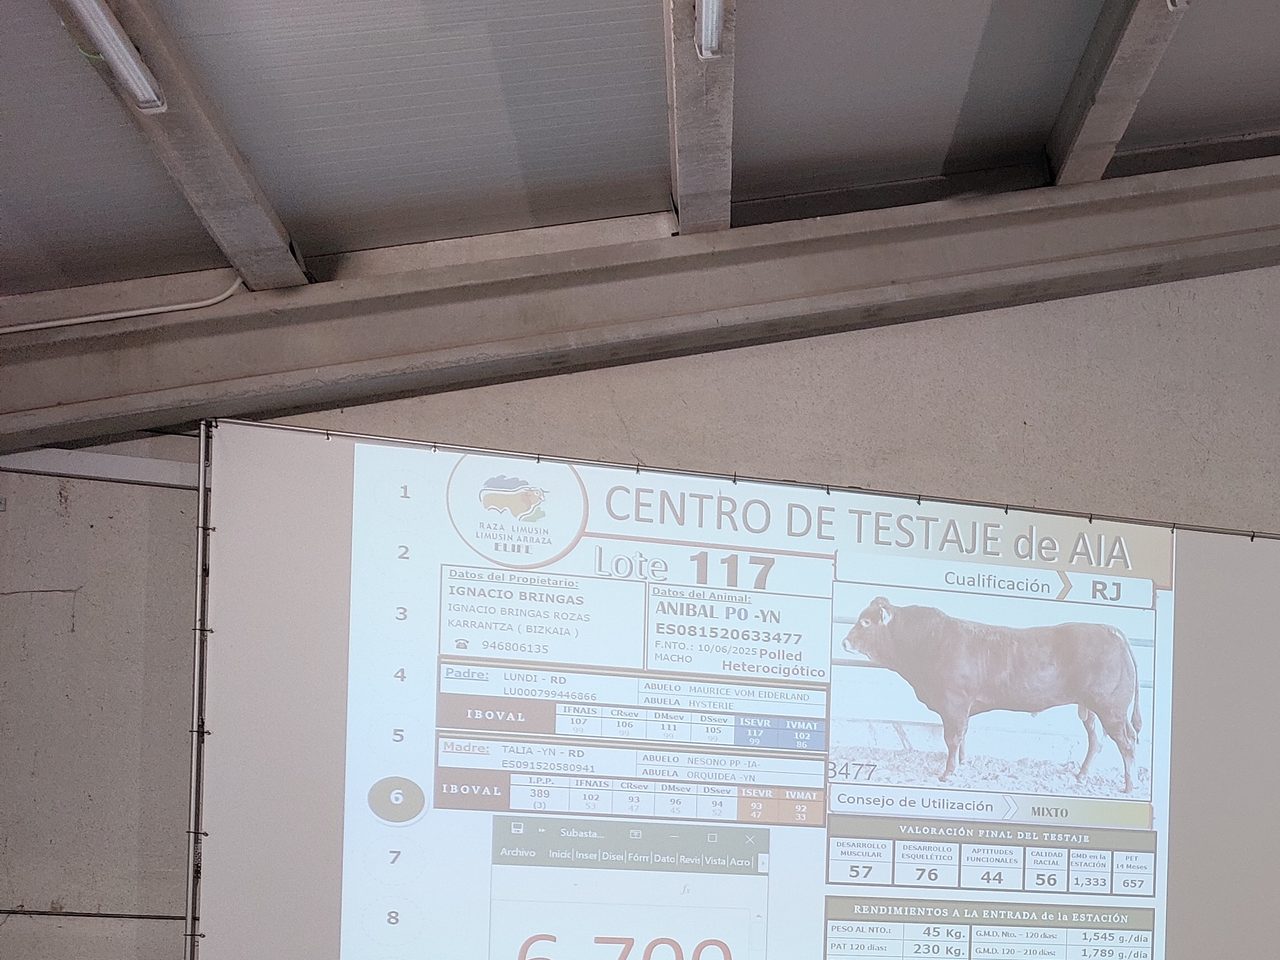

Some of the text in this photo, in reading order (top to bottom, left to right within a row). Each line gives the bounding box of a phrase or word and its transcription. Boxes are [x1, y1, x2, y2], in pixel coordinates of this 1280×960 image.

[400, 485, 411, 499] 1
[512, 525, 549, 535] LIMUSIN
[605, 486, 1133, 570] CENTRO DE TESTAJE de AIA
[476, 532, 513, 541] LIMUSIN
[398, 545, 410, 559] 2
[594, 545, 776, 590] Lote 117
[449, 570, 579, 588] Datos del Propietario:
[944, 571, 1122, 601] Cualificación RJ
[449, 586, 585, 606] IGNACIO BRINGAS
[652, 587, 752, 603] Datos del Animal:
[395, 607, 408, 620] 3
[448, 604, 591, 622] IGNACIO BRINGAS ROZAS
[655, 600, 719, 619] ANIBAL
[754, 609, 781, 624] -YN
[447, 619, 571, 636] KARRANTZA BIZKAIA
[656, 623, 802, 645] ES081520633477
[482, 640, 549, 654] 946806135
[698, 644, 758, 656] 10/06/2025
[759, 649, 802, 662] Polled
[654, 654, 826, 678] MACHO Heterocigótico
[393, 668, 406, 682] 4
[445, 668, 489, 680] Padre:
[503, 672, 567, 684] LUNDI RD
[644, 683, 810, 701] ABUELO MAURICE VOM EIDERLAND
[644, 697, 734, 710] ABUELA HYSTERIE
[466, 710, 525, 722] IBOVAL
[392, 729, 405, 743] 5
[616, 721, 634, 729] 106
[705, 726, 722, 734] 105
[746, 729, 763, 737] 117
[794, 732, 811, 740] 102
[443, 741, 490, 754] Madre:
[502, 745, 533, 755] TALIA
[568, 749, 585, 757] RD
[642, 754, 679, 763] ABUELO
[687, 757, 726, 767] NESONO
[729, 759, 741, 767] PP
[642, 769, 679, 777] ABUELA
[686, 771, 736, 782] ORQUIDEA
[442, 784, 502, 796] IBOVAL
[389, 790, 404, 805] 6
[530, 789, 550, 799] 389
[583, 793, 600, 801] 102
[628, 796, 640, 804] 93
[670, 798, 682, 806] 96
[750, 802, 763, 810] 93
[837, 793, 1069, 818] Consejo de Utilización MIXTO
[899, 825, 1090, 843] VALORACIÓN FINAL DEL TESTAJE
[500, 848, 536, 857] Archivo
[836, 841, 887, 850] DESARROLLO
[902, 844, 952, 853] DESARROLLO
[840, 849, 882, 858] MUSCULAR
[388, 850, 401, 864] 7
[849, 866, 1144, 889] 57 76 44 56 1,333 657
[386, 910, 400, 925] 8
[854, 905, 1129, 923] RENDIMIENTOS A LA ENTRADA de la ESTACIÓN
[831, 925, 853, 933] PESO
[923, 927, 966, 940] 45 Kg.
[1082, 932, 1115, 943] 1,545
[913, 944, 965, 957] 230 Kg.
[1081, 948, 1114, 959] 1,789
